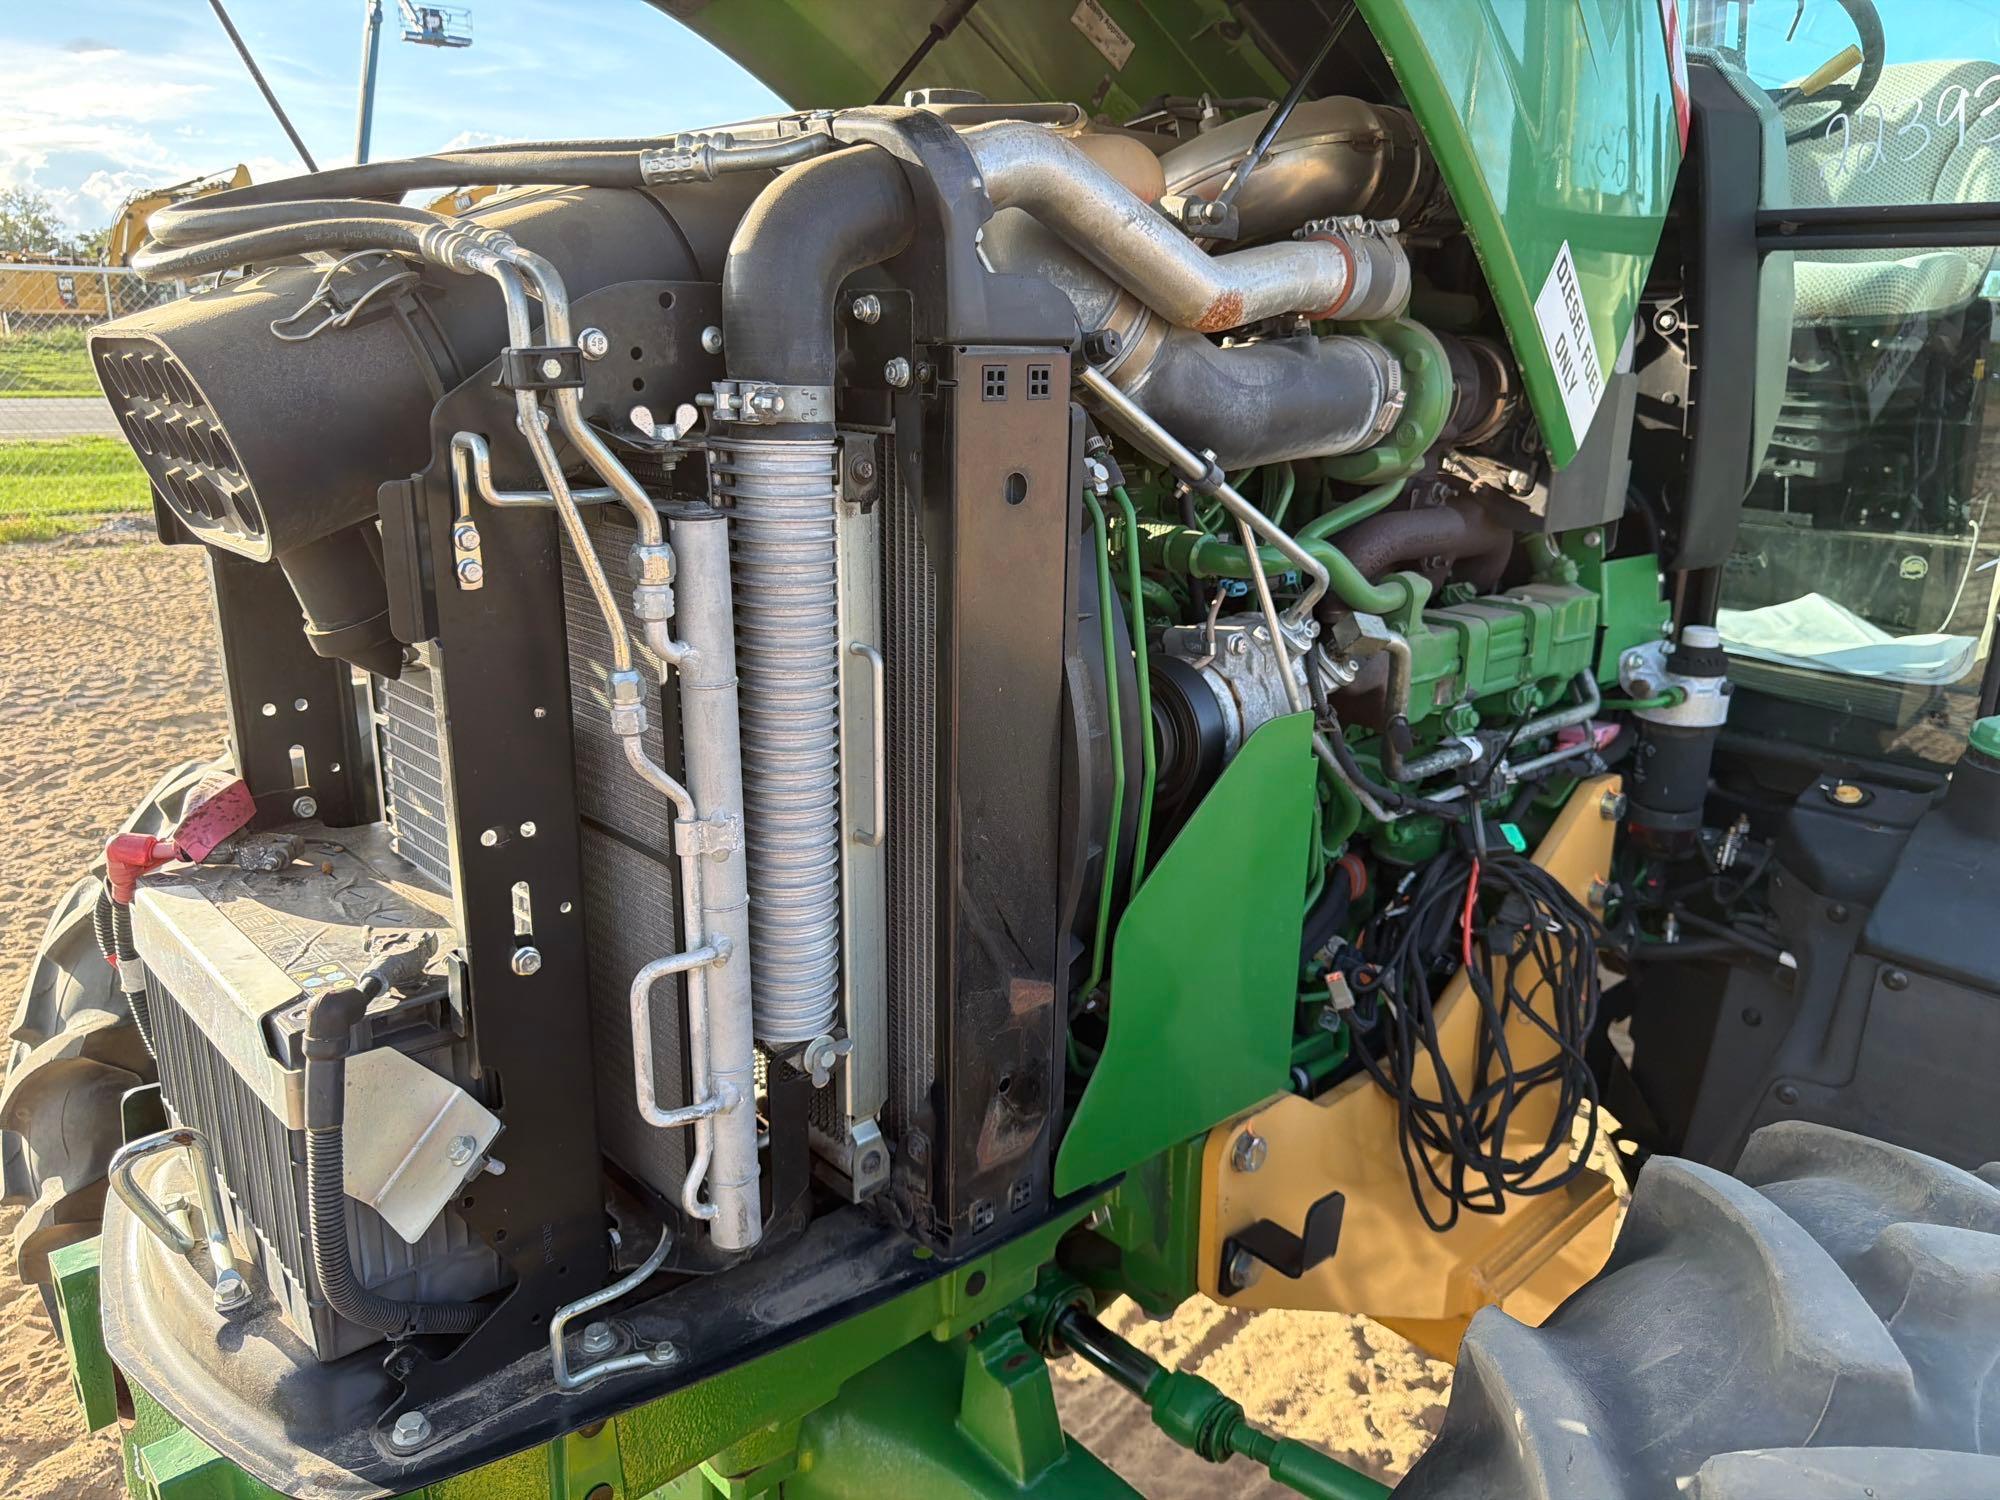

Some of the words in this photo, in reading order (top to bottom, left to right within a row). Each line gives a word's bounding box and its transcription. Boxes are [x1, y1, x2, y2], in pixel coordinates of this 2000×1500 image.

[1555, 332, 1577, 395] ONLY
[1556, 256, 1586, 350] DIESEL
[1581, 343, 1600, 404] FUEL
